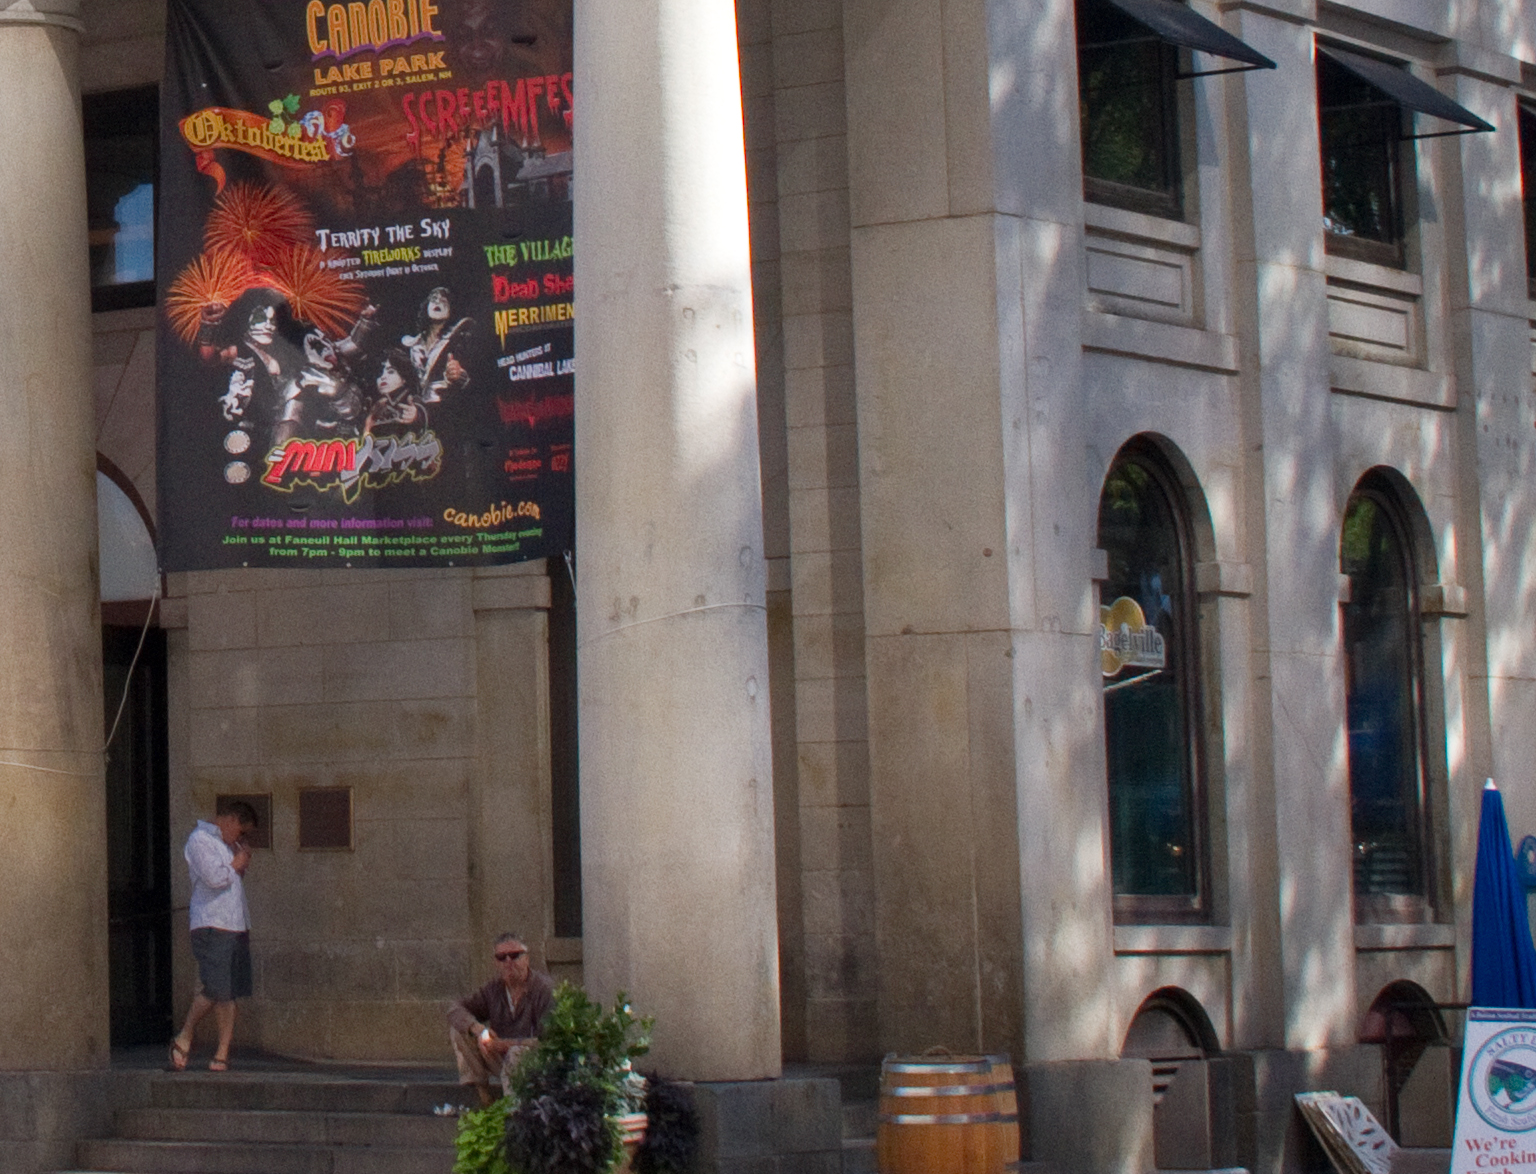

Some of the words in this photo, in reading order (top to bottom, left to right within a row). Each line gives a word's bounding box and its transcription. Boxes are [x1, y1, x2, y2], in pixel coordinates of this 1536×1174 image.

[314, 61, 373, 85] LAKE
[379, 51, 447, 76] PARK
[309, 86, 337, 97] ROUTE
[338, 85, 351, 94] 93,
[353, 81, 372, 91] EXIT
[374, 79, 380, 88] 2
[381, 78, 394, 87] OR
[405, 72, 437, 84] SALEM,
[438, 71, 452, 80] NH
[402, 72, 573, 148] SCREEEMFES
[184, 110, 330, 162] Oktoberfest
[385, 224, 414, 244] THE
[420, 218, 450, 240] SKY
[484, 244, 518, 267] THE
[520, 235, 573, 262] VILLAG
[494, 302, 574, 350] MERRIMEN
[509, 361, 555, 381] CANNIBAL
[231, 516, 249, 528] For
[252, 516, 284, 528] dates
[286, 516, 307, 528] and
[309, 518, 339, 528] more
[341, 516, 404, 528] information
[443, 501, 541, 528] canobie.com
[222, 536, 247, 545] Join
[269, 536, 281, 544] at
[285, 536, 330, 545] Faneuil
[334, 536, 358, 545] Hall
[362, 535, 437, 546] Marketplace
[440, 534, 473, 544] every
[269, 547, 298, 556] from
[301, 547, 328, 558] 7pm
[339, 548, 364, 558] 9pm
[368, 548, 381, 556] to
[384, 547, 415, 556] meet
[430, 546, 479, 555] Canobie
[1465, 1137, 1517, 1152] We're
[1475, 1150, 1536, 1168] Cookin
